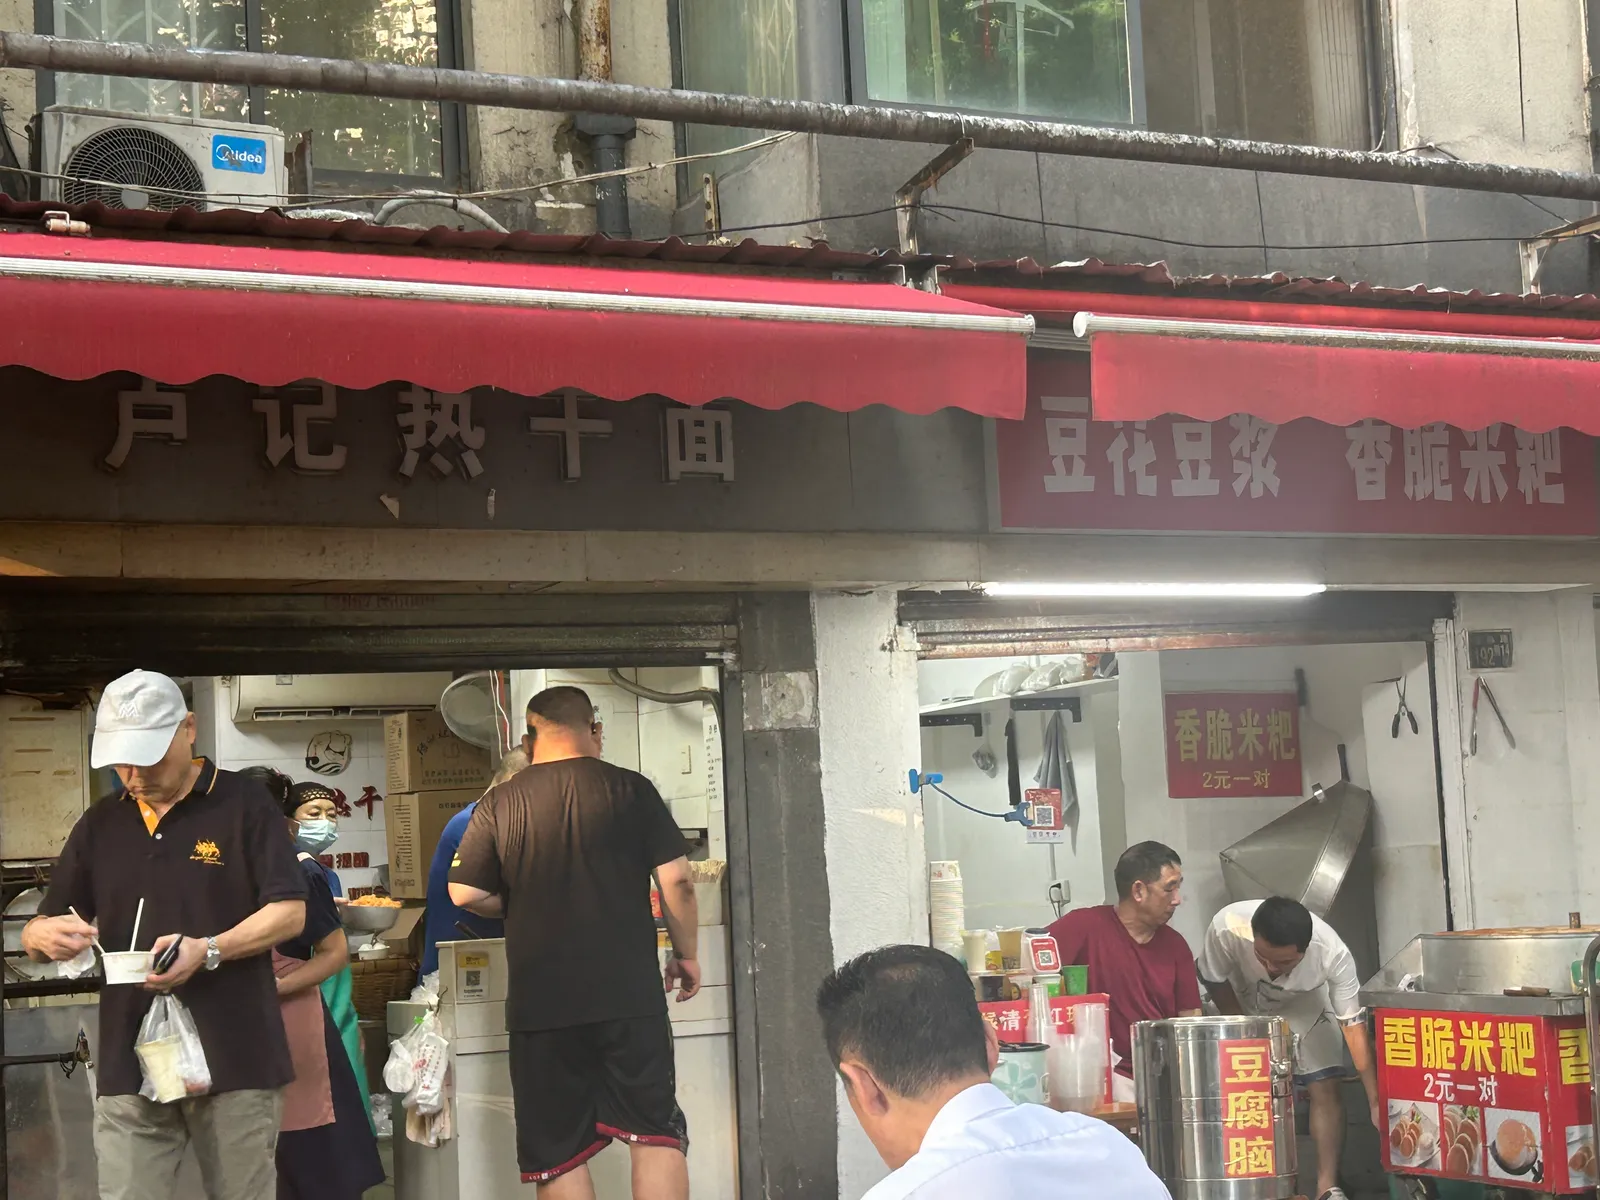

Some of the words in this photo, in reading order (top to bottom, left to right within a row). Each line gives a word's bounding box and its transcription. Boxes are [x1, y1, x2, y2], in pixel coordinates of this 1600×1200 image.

[1040, 396, 1281, 499] 豆花豆浆
[1345, 418, 1566, 505] 香脆米粑
[1173, 708, 1295, 763] 香脆米粑
[1202, 768, 1271, 790] 2元一对
[1383, 1016, 1537, 1077] 香脆米粑
[1224, 1046, 1274, 1176] 豆腐脑
[1423, 1072, 1498, 1106] 2元一对
